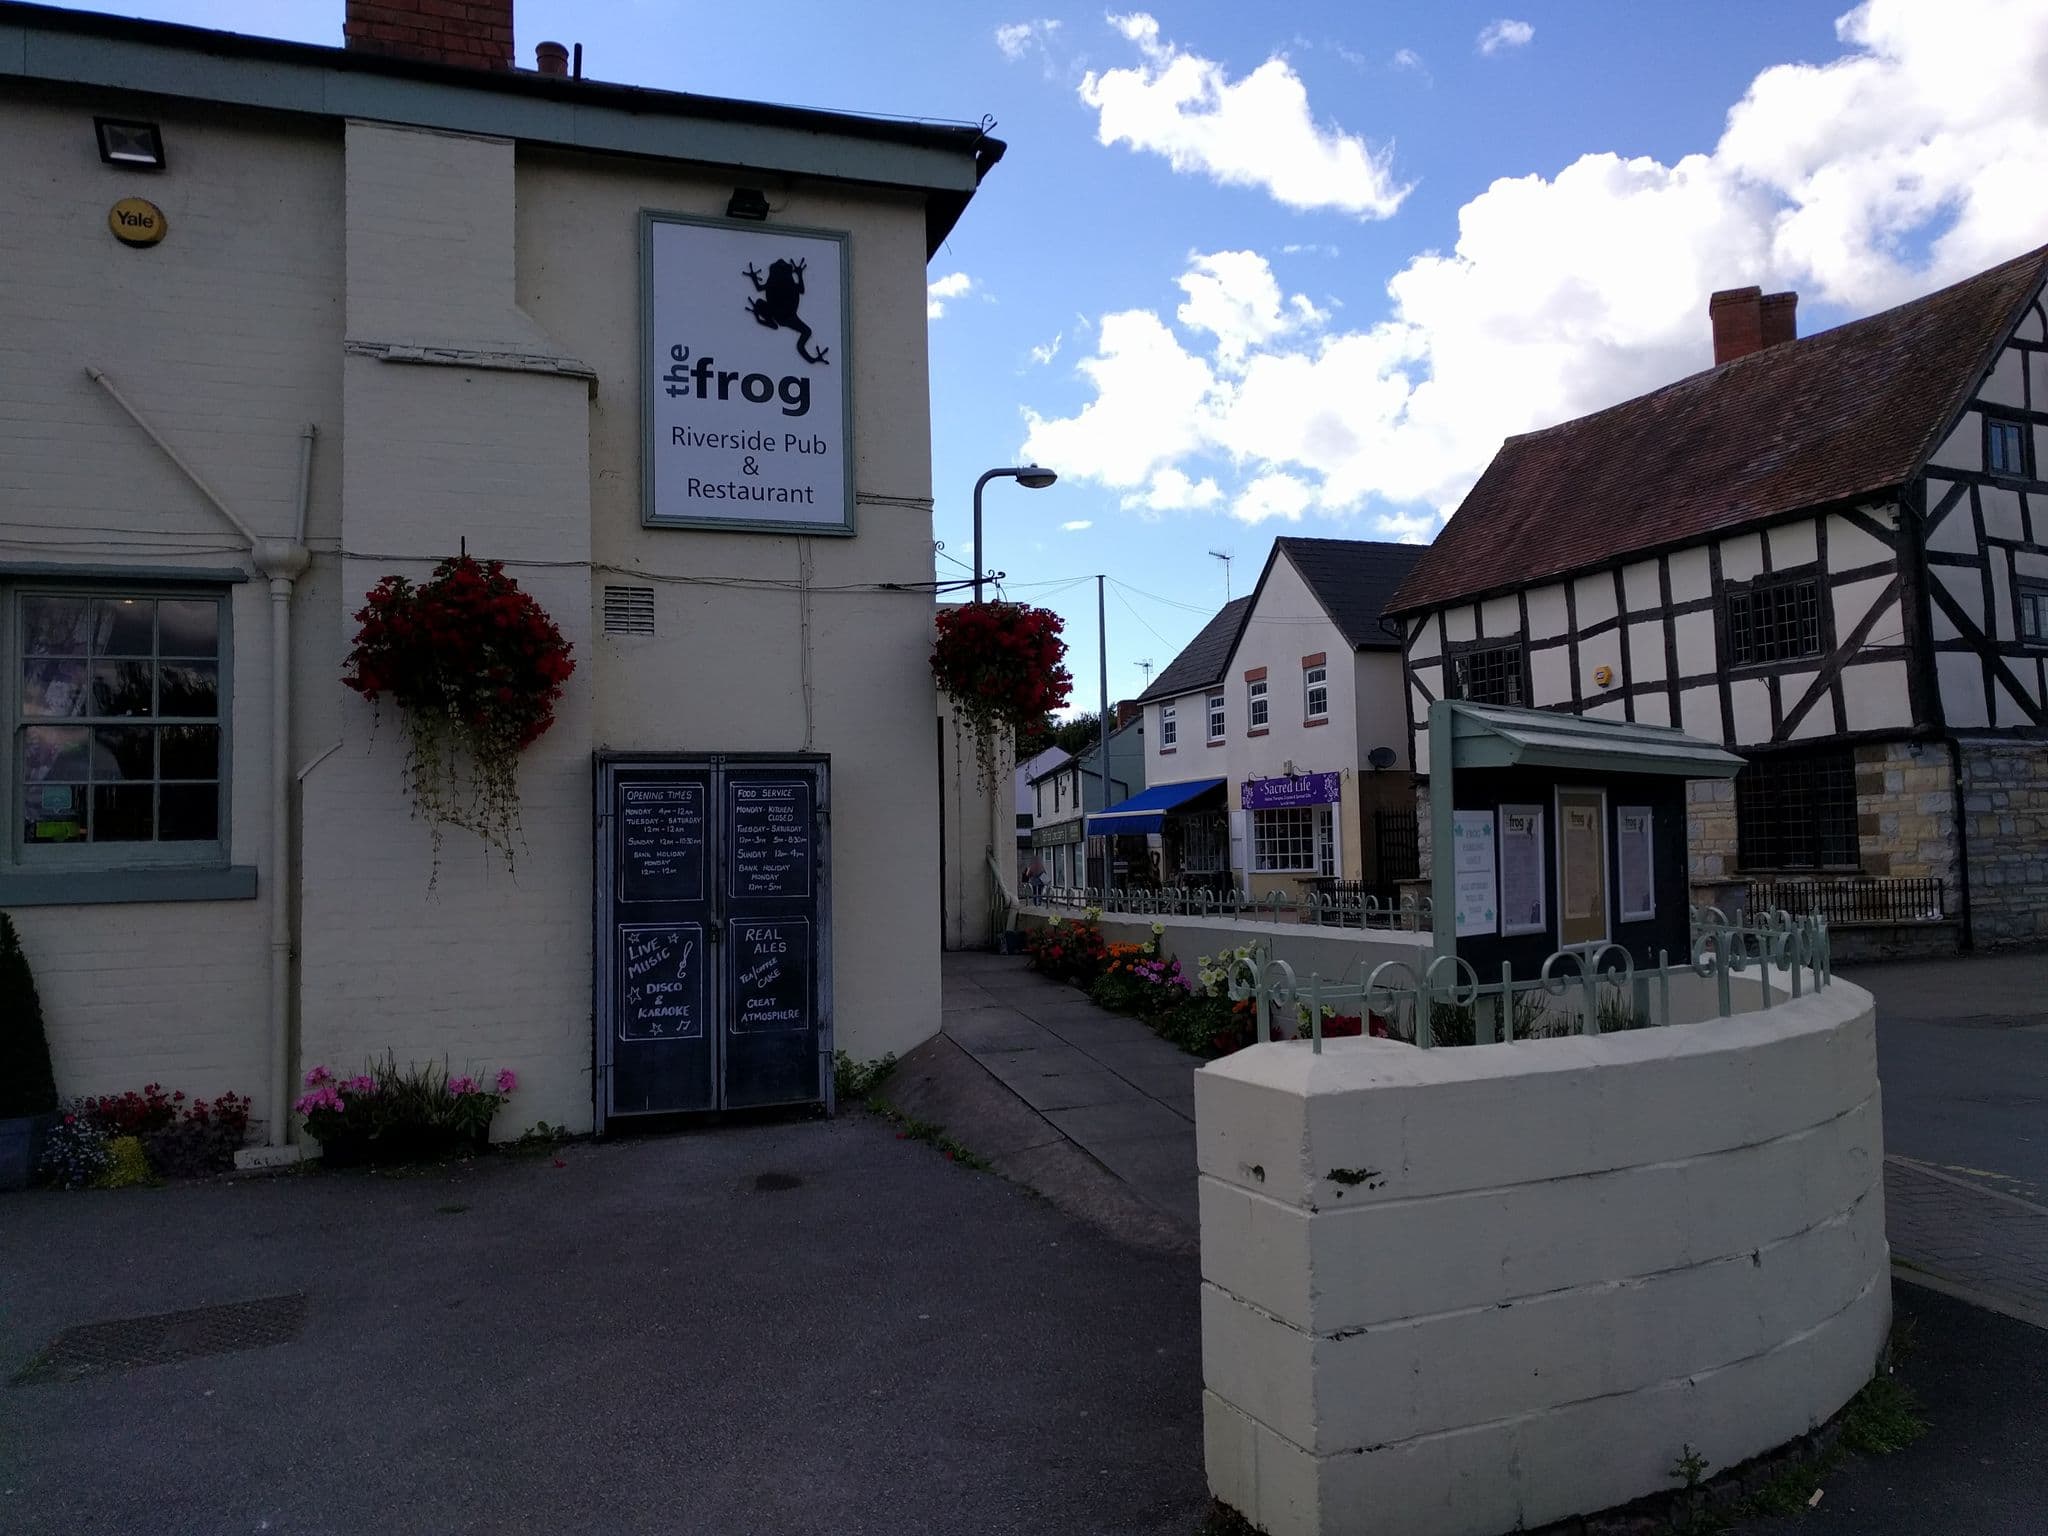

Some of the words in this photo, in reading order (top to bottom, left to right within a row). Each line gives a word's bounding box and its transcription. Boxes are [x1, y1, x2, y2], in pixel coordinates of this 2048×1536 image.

[117, 210, 154, 228] Yale
[663, 344, 690, 398] the
[690, 357, 811, 417] frog
[672, 426, 776, 452] Riverside
[784, 434, 827, 455] Pub
[742, 455, 759, 476] &
[688, 478, 815, 504] Restaurant
[1264, 778, 1293, 795] Sacred
[1295, 776, 1311, 792] Life
[626, 791, 664, 801] OPENING
[667, 791, 693, 800] TIMES
[737, 789, 757, 798] FOOD
[762, 789, 793, 798] SERVICE
[625, 808, 652, 816] MONDAY
[736, 806, 763, 814] MONDAY
[668, 817, 702, 825] SATURDAY
[767, 814, 794, 822] CLOSED
[1509, 814, 1524, 829] frog
[628, 837, 655, 846] SUNDAY
[737, 848, 768, 859] SUNDAY
[738, 864, 758, 872] BANK
[762, 864, 791, 872] HOLIDAY
[745, 928, 782, 942] REAL
[628, 937, 661, 961] LIVE
[753, 942, 787, 954] ALES
[628, 947, 670, 980] MUSIC
[757, 968, 781, 988] CAKE
[646, 982, 683, 994] DISCO
[746, 997, 776, 1008] GREAT
[637, 1005, 690, 1019] KARAOKE
[740, 1009, 800, 1023] ATMOSPHERE
